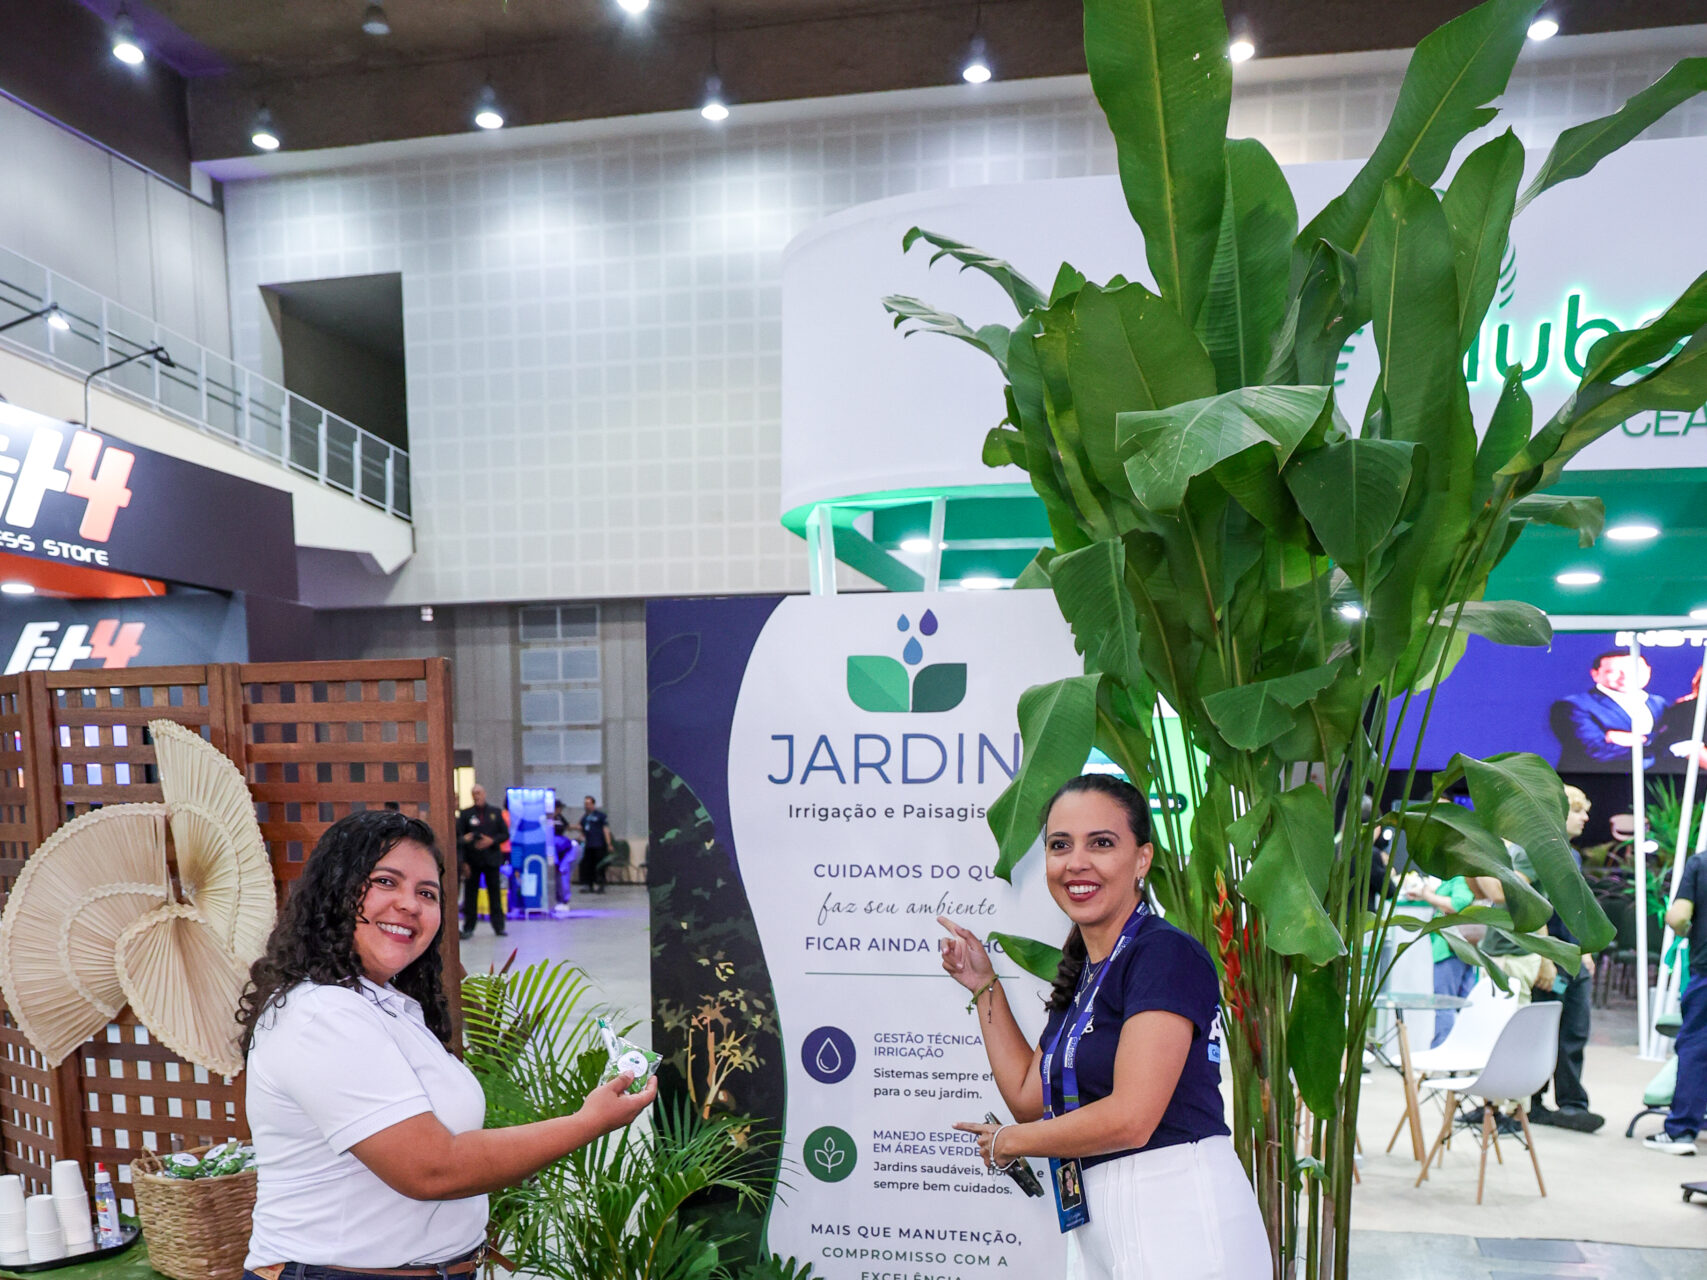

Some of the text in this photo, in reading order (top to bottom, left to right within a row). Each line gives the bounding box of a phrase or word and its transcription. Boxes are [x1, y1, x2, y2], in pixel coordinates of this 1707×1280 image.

[788, 804, 986, 822] Irrigação e Paisagis
[813, 864, 997, 881] CUIDAMOS DO QU
[817, 891, 997, 926] faz seu ambiente
[805, 936, 861, 951] FICAR
[867, 937, 930, 952] AINDA
[873, 1032, 983, 1046] GESTÃO TÉCNICA
[873, 1045, 944, 1060] IRRIGAÇÃO
[873, 1067, 929, 1080] Sistemas
[931, 1072, 979, 1082] sempre
[873, 1087, 983, 1100] para o seu jardim.
[873, 1130, 926, 1141] MANEJO
[873, 1142, 982, 1156] EM ÁREAS VERDE
[873, 1161, 917, 1173] Jardins
[920, 1163, 984, 1177] saudáveis,
[1036, 1169, 1044, 1178] e
[873, 1181, 1013, 1195] sempre bem cuidados.
[811, 1223, 1022, 1246] MAIS QUE MANUTENÇÃO,
[822, 1247, 1008, 1267] COMPROMISSO COM A
